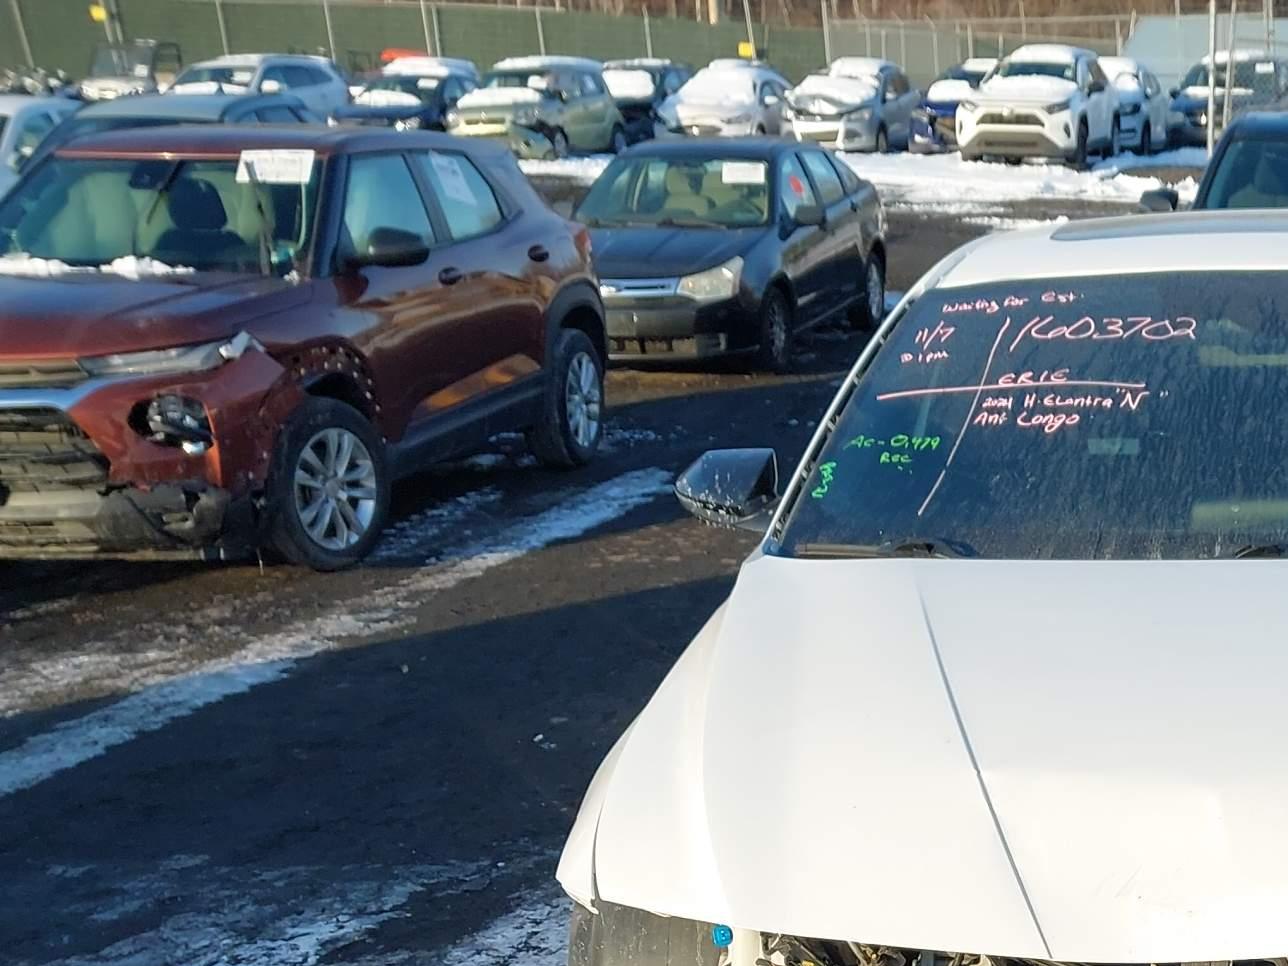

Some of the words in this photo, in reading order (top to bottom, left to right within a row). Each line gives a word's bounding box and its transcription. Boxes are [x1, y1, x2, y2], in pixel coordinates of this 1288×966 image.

[914, 320, 955, 350] 11/7
[1009, 316, 1196, 352] 1603702
[999, 368, 1069, 385] ERIE
